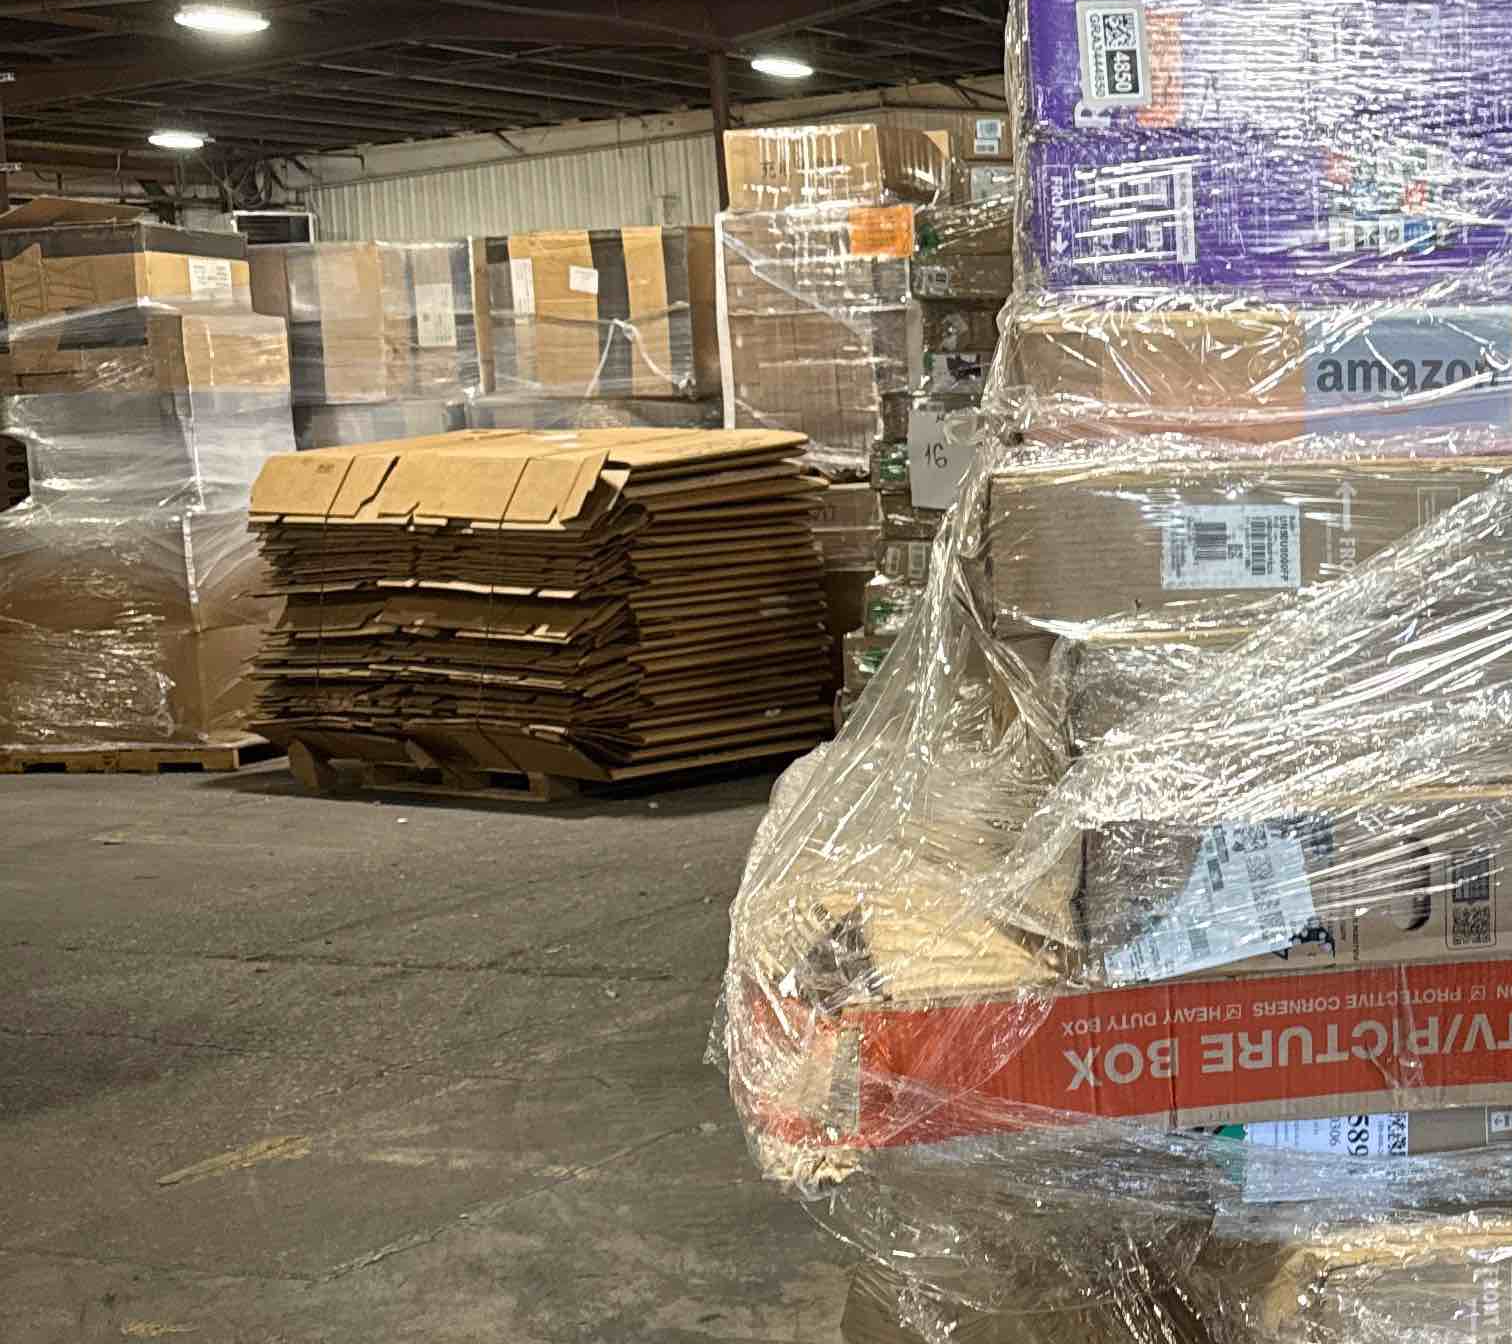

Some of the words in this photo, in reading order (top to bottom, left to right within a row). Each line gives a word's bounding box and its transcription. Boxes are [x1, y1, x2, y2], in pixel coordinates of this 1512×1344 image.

[1112, 51, 1132, 92] 4850
[1049, 175, 1065, 228] FRONT
[924, 442, 948, 468] 16
[1252, 996, 1341, 1018] CORNERS
[1346, 986, 1462, 1013] PROTECTIVE
[1106, 1009, 1157, 1030] DUTY
[1161, 1003, 1222, 1024] HEAVY
[1061, 1017, 1102, 1037] BOX
[1063, 1039, 1182, 1093] BOX
